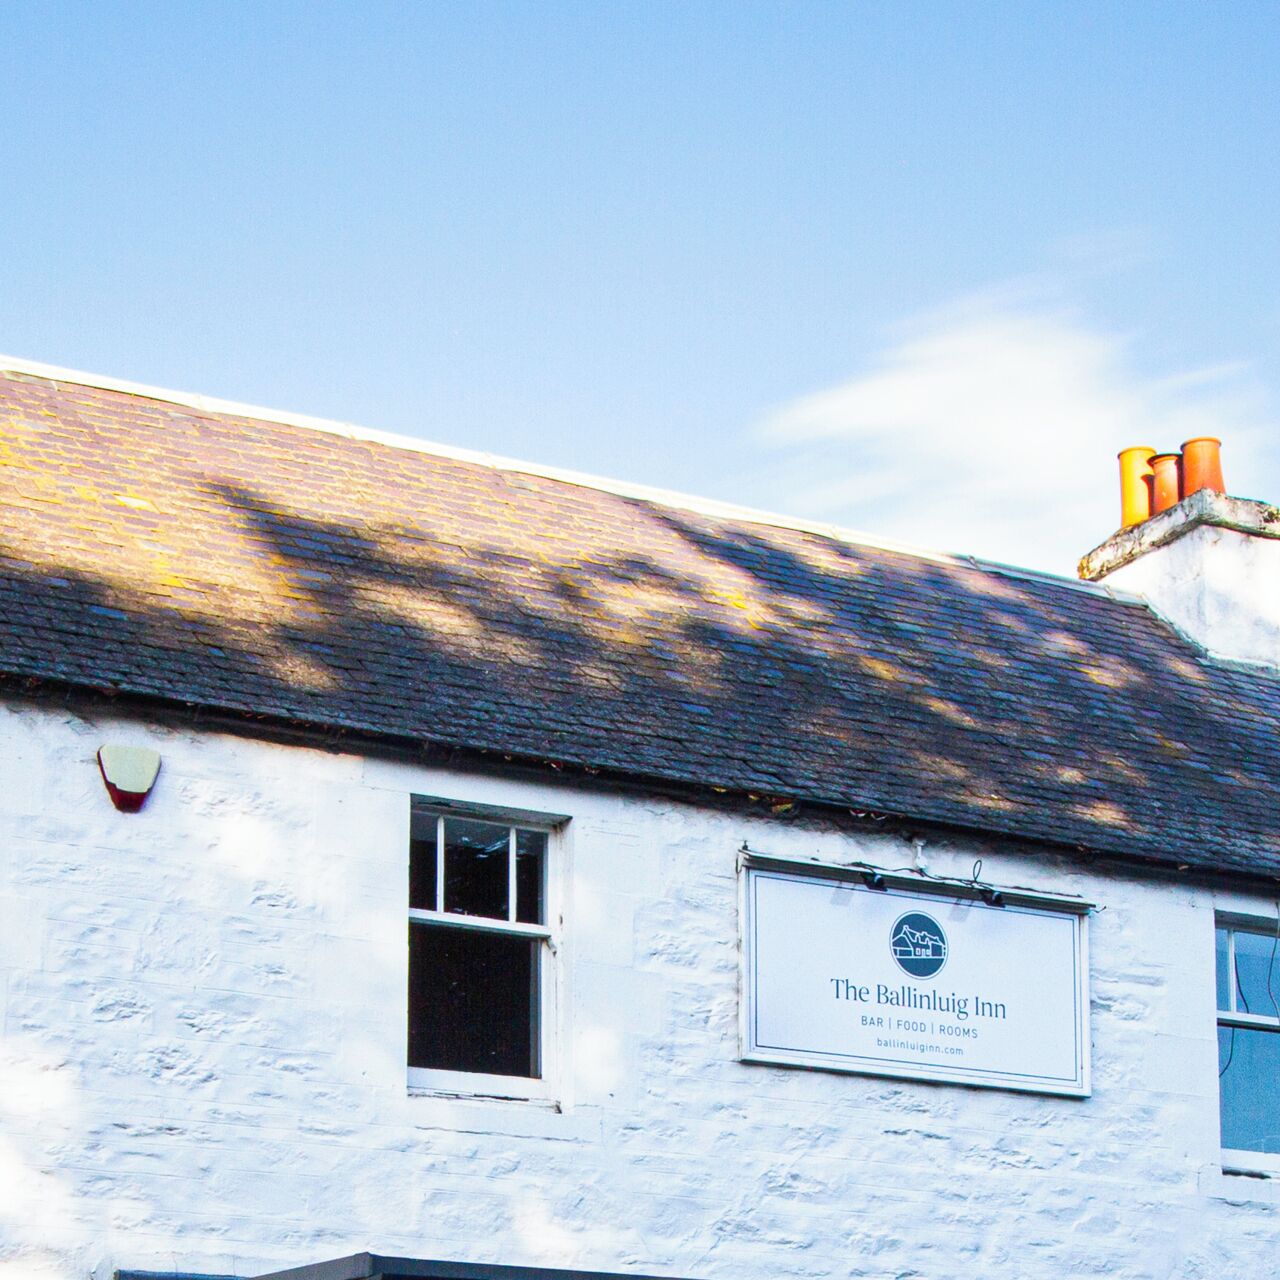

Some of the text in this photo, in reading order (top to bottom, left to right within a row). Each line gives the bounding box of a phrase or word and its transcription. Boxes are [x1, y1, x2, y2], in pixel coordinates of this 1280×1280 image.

[830, 978, 1006, 1021] The Ballinluig Inn
[861, 1015, 979, 1039] BAR FOOD ROOMS
[876, 1037, 964, 1056] ballinluiginn.com
